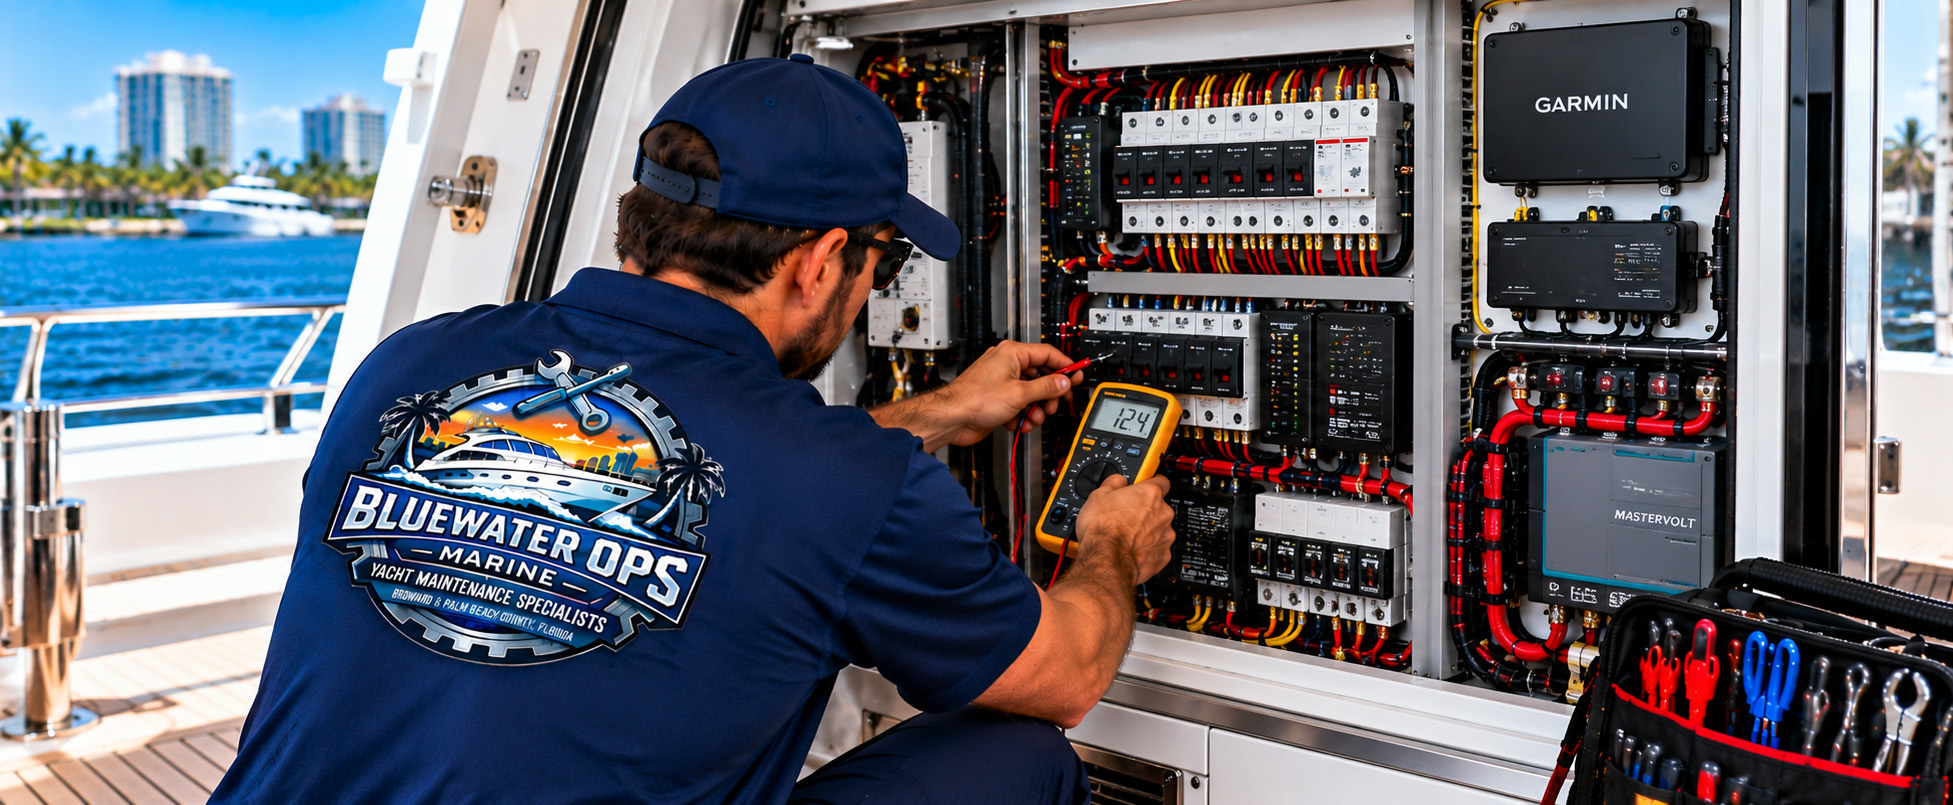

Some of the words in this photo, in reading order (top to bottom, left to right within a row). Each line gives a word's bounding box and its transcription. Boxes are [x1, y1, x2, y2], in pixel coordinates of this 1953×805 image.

[1534, 93, 1628, 114] GARMIN
[1112, 408, 1151, 433] 12.4
[1614, 509, 1697, 529] MASTERVOLT
[341, 484, 582, 564] BLUEWATER
[586, 537, 689, 608] OPS
[438, 545, 558, 587] MARINE
[370, 562, 415, 583] YACHT
[415, 570, 515, 606] MAINTENANCE
[516, 593, 608, 634] SPECIALISTS
[442, 598, 470, 613] PALM
